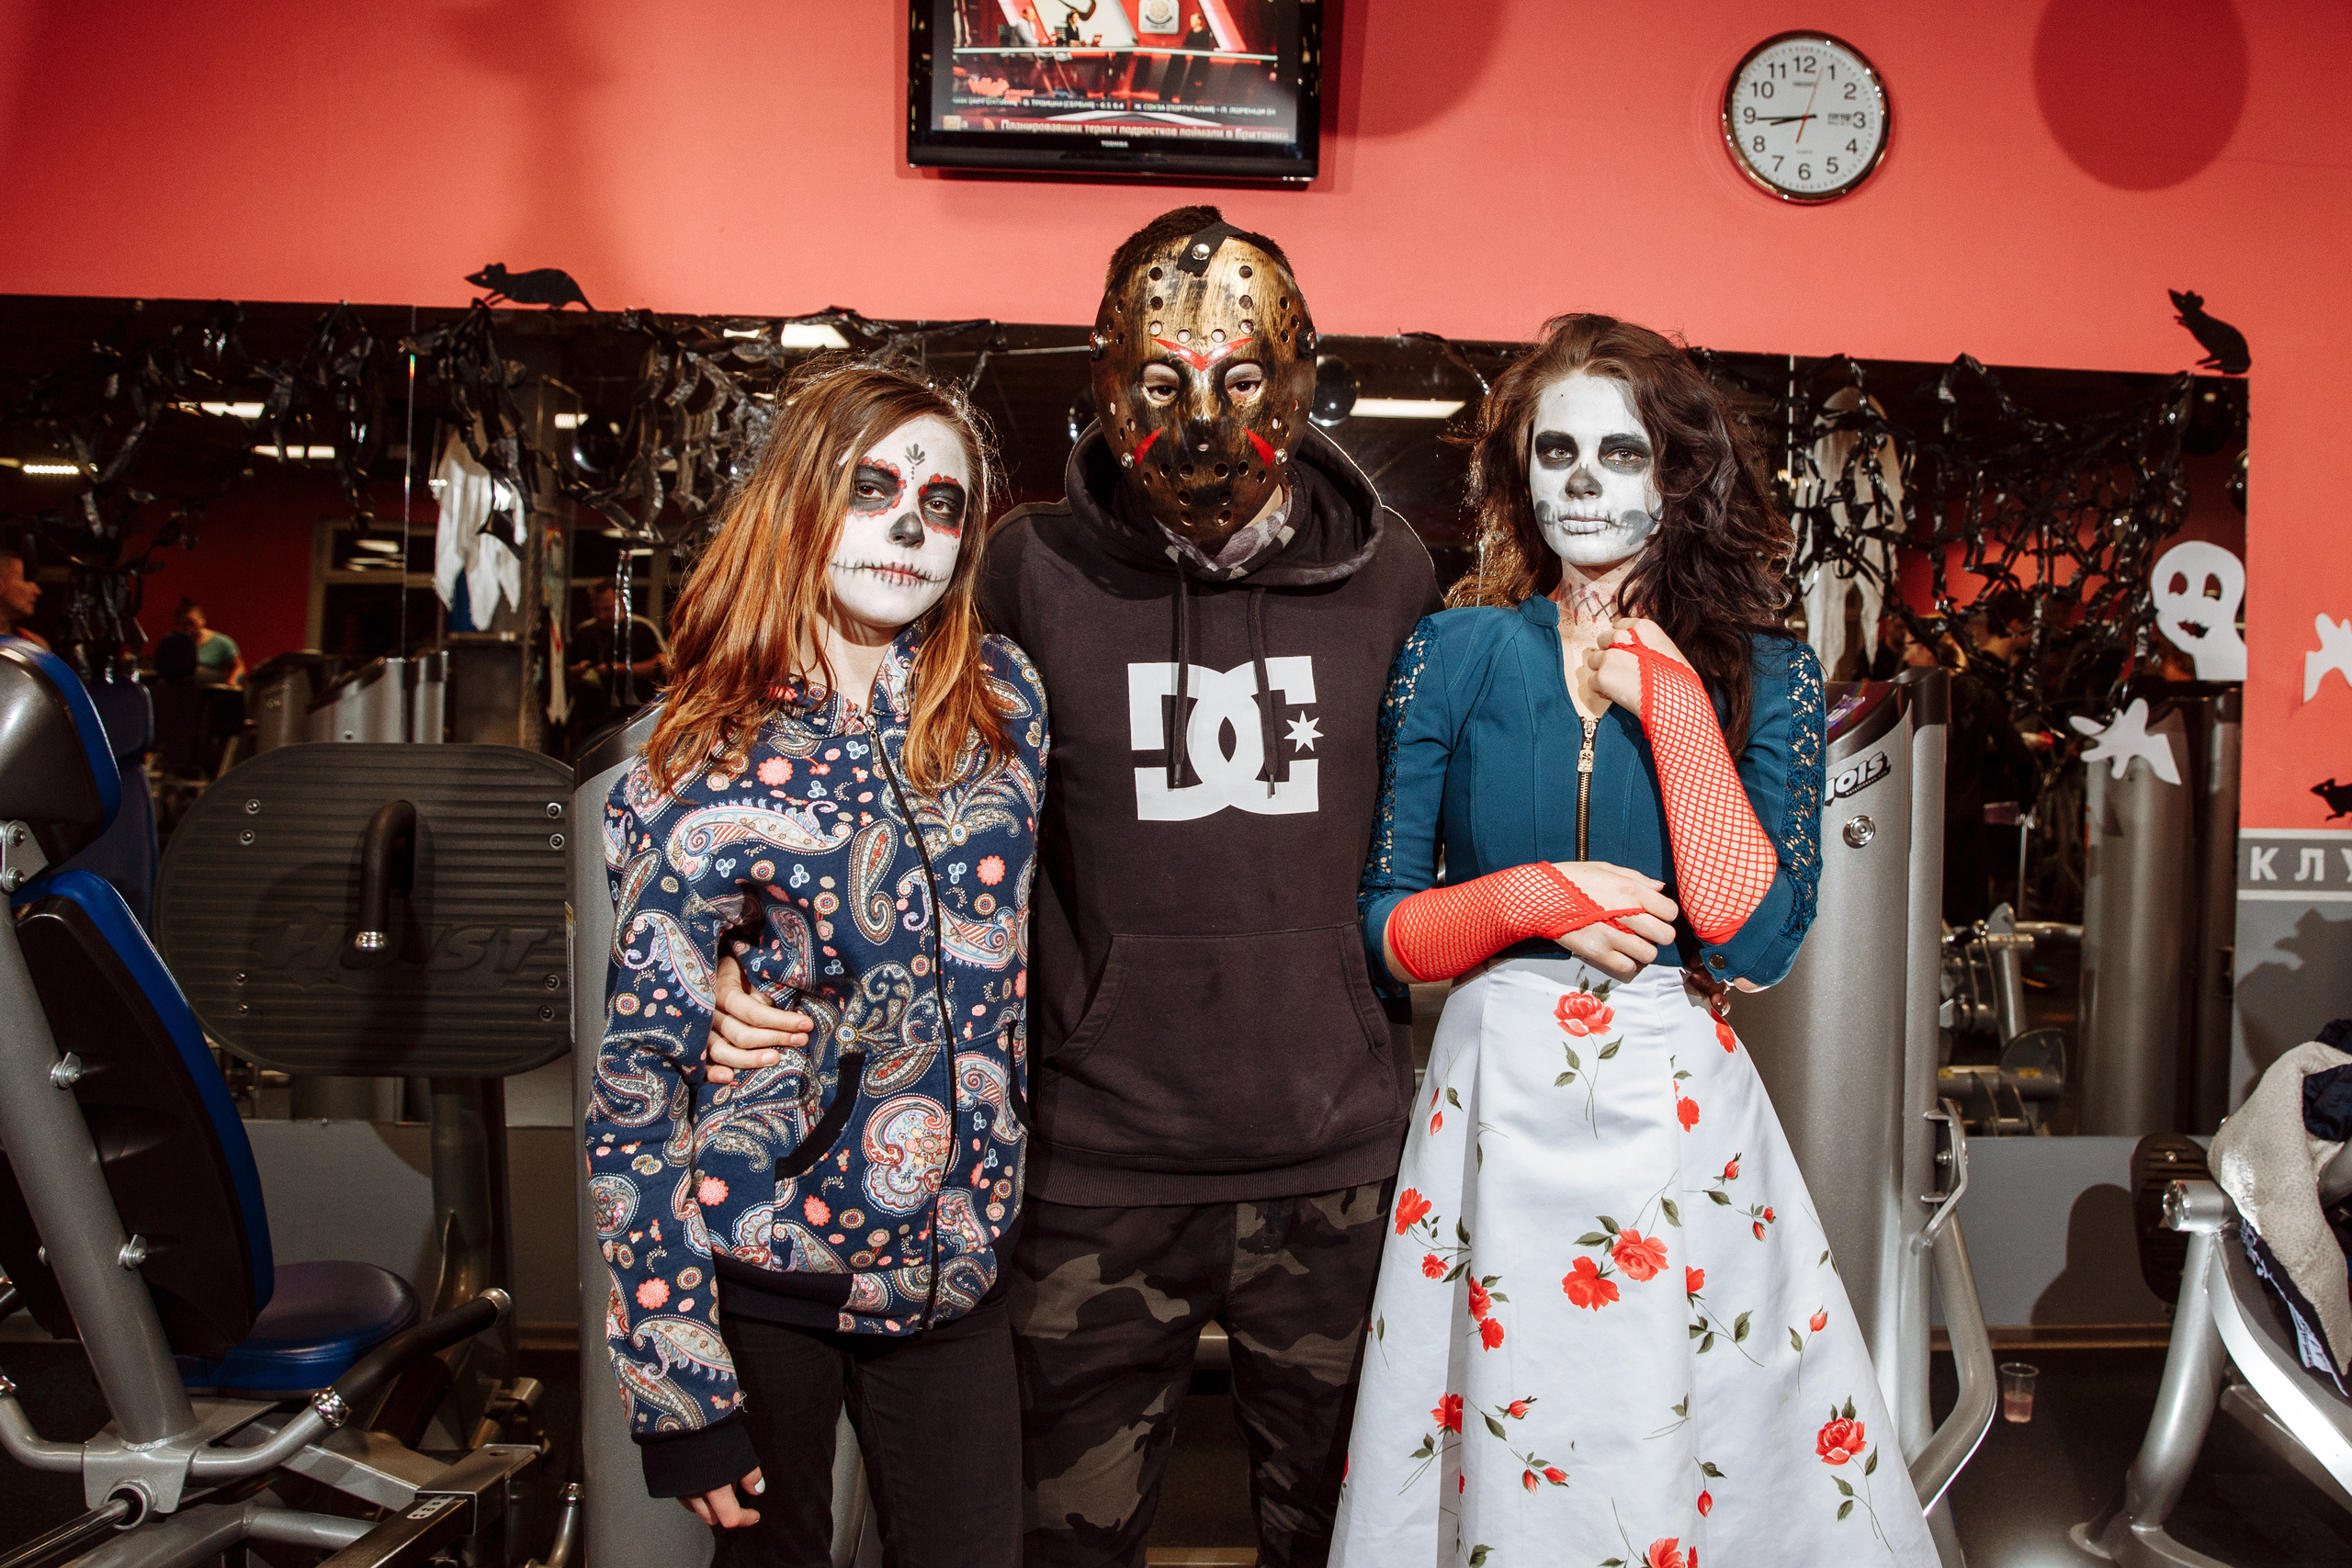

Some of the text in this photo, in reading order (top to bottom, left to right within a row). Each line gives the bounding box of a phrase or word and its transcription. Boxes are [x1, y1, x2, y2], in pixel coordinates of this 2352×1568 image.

[1768, 62, 1786, 79] 11
[1793, 55, 1816, 73] 12
[1828, 63, 1836, 80] 1
[1751, 81, 1774, 98] 10
[1844, 82, 1857, 100] 2
[1743, 107, 1757, 124] 9
[1853, 111, 1866, 129] 3
[1085, 124, 1117, 135] теракт
[1119, 126, 1178, 137] подростков
[1180, 127, 1224, 138] поймали
[1753, 135, 1766, 152] 8
[1846, 139, 1858, 154] 4
[1772, 155, 1784, 172] 7
[1798, 163, 1811, 181] 6
[1826, 157, 1838, 174] 5
